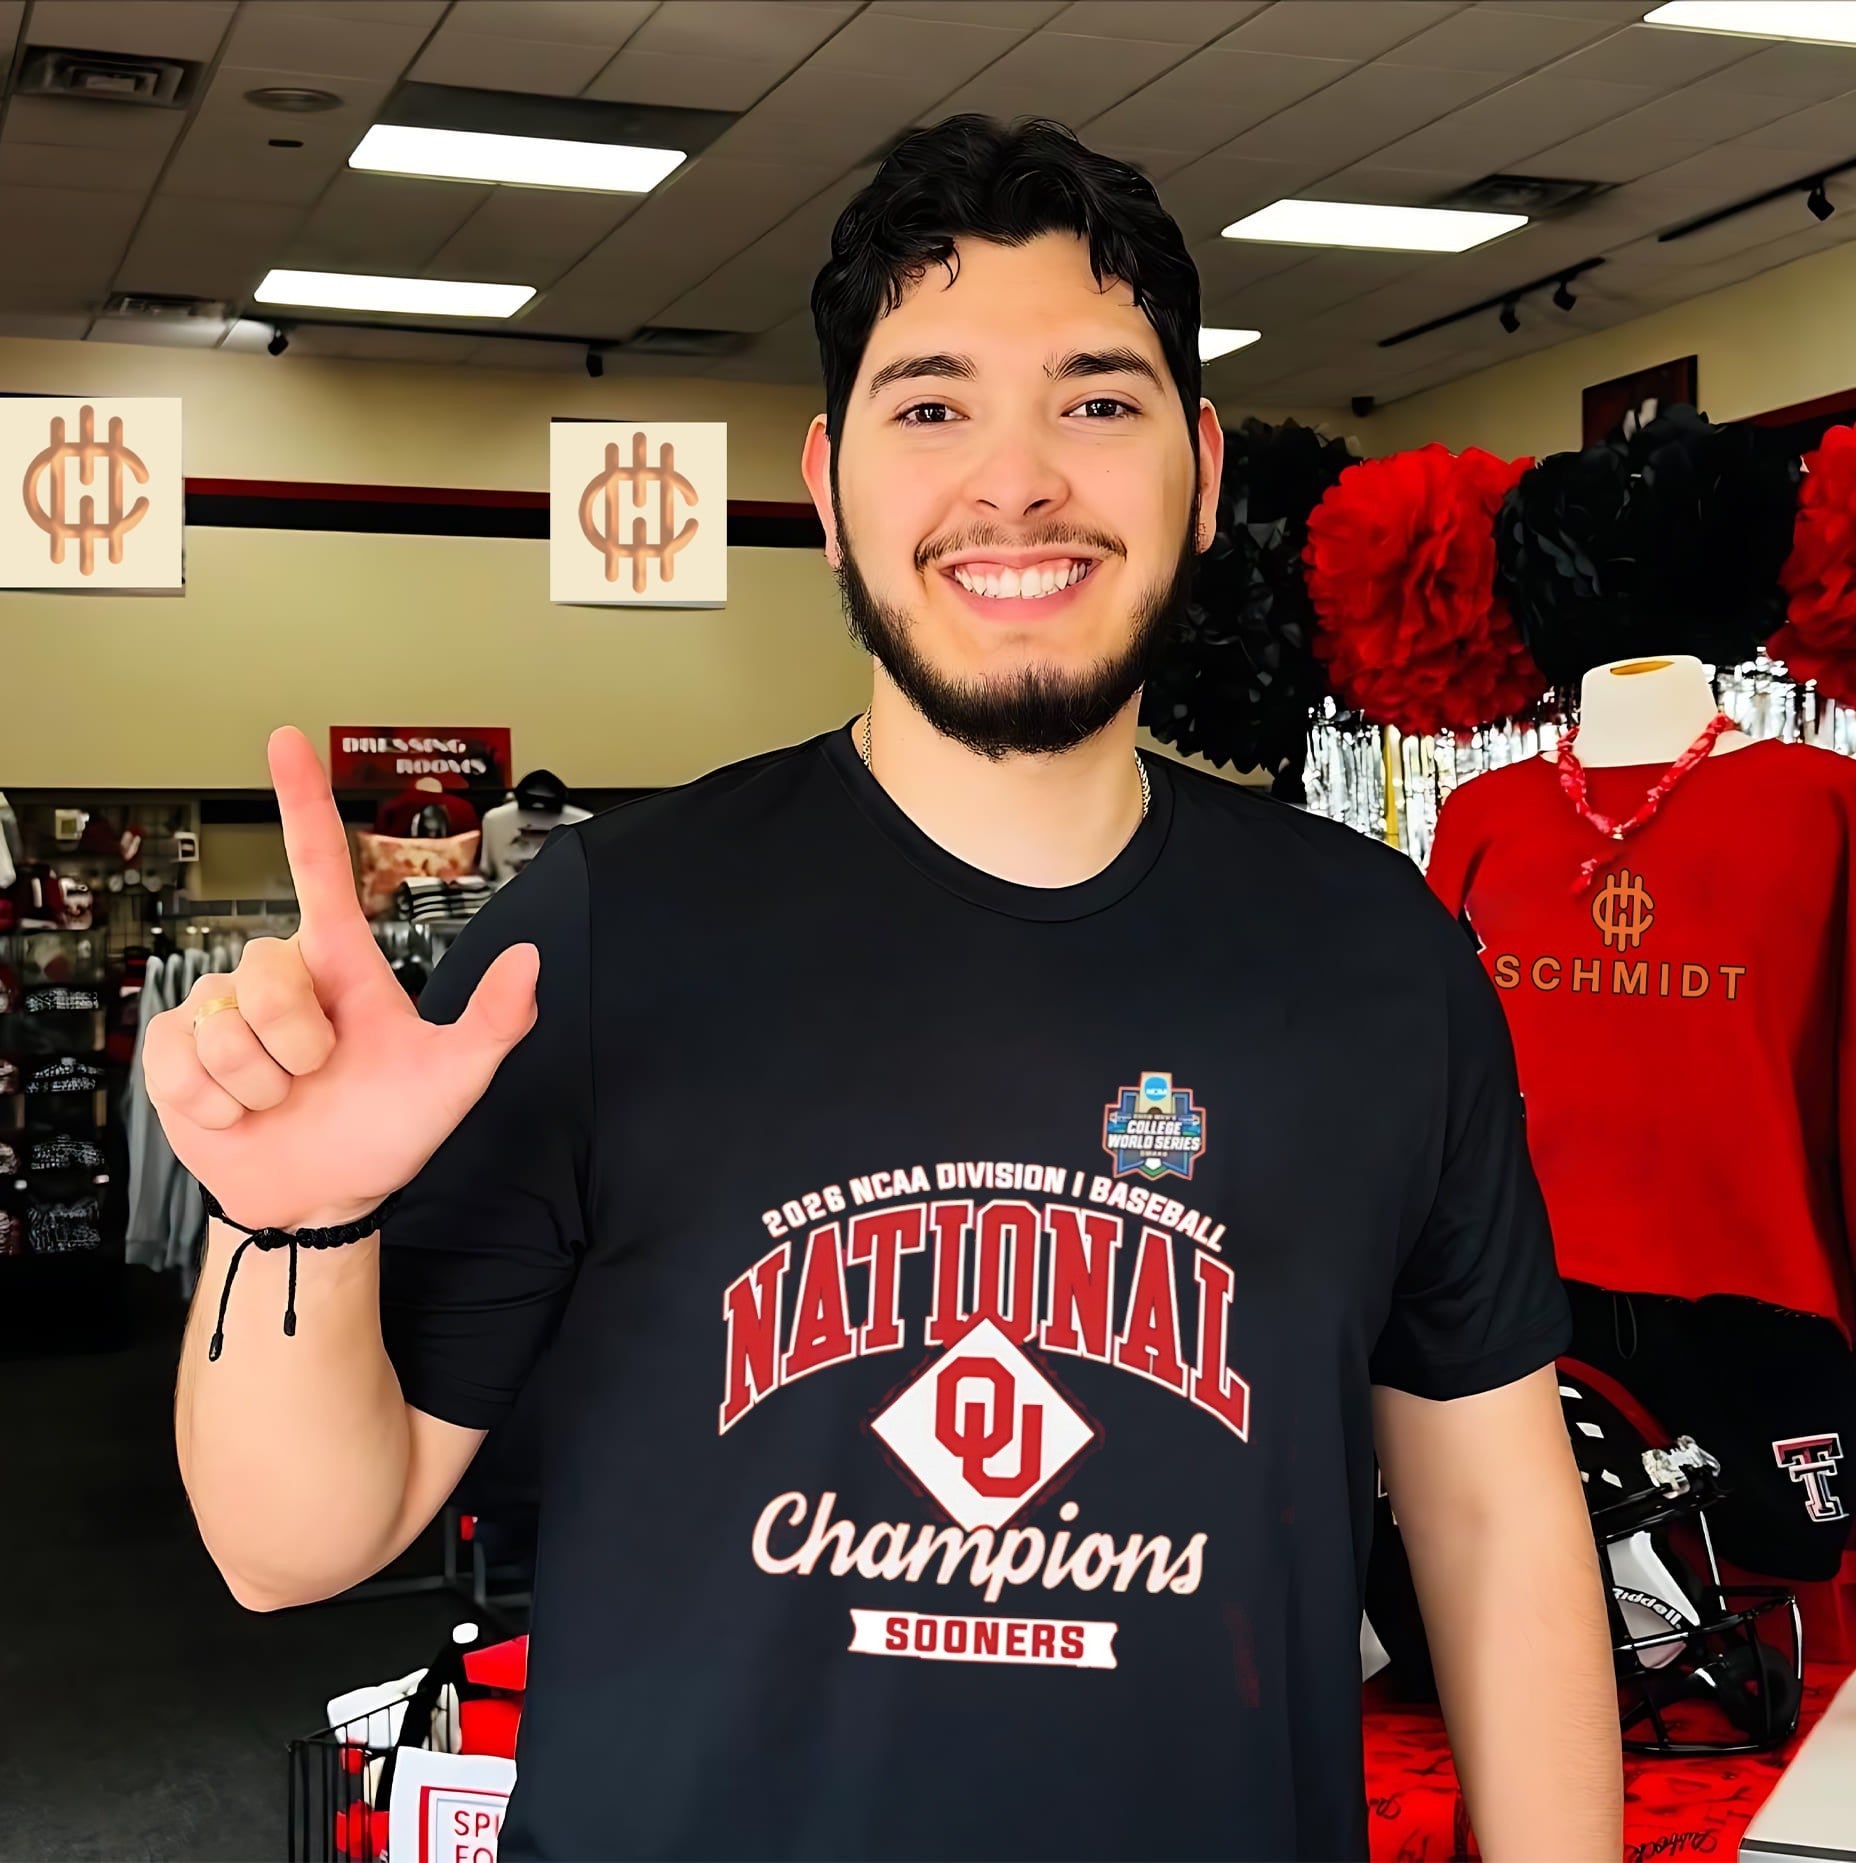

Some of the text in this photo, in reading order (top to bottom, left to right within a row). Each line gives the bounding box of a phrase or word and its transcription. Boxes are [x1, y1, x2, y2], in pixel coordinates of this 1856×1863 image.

[342, 738, 466, 753] DRESSING
[396, 758, 487, 774] ROOMS
[1494, 953, 1747, 1000] SCHMIDT
[1107, 1134, 1201, 1151] WORLD SERIES
[1127, 1120, 1182, 1136] COLLEGE
[762, 1162, 1226, 1252] 2026 NCAA DIVISION I BASEBALL
[718, 1199, 1250, 1443] NATIONAL
[935, 1356, 1044, 1499] OU
[752, 1492, 1208, 1603] Champions
[885, 1616, 1085, 1660] SOONERS
